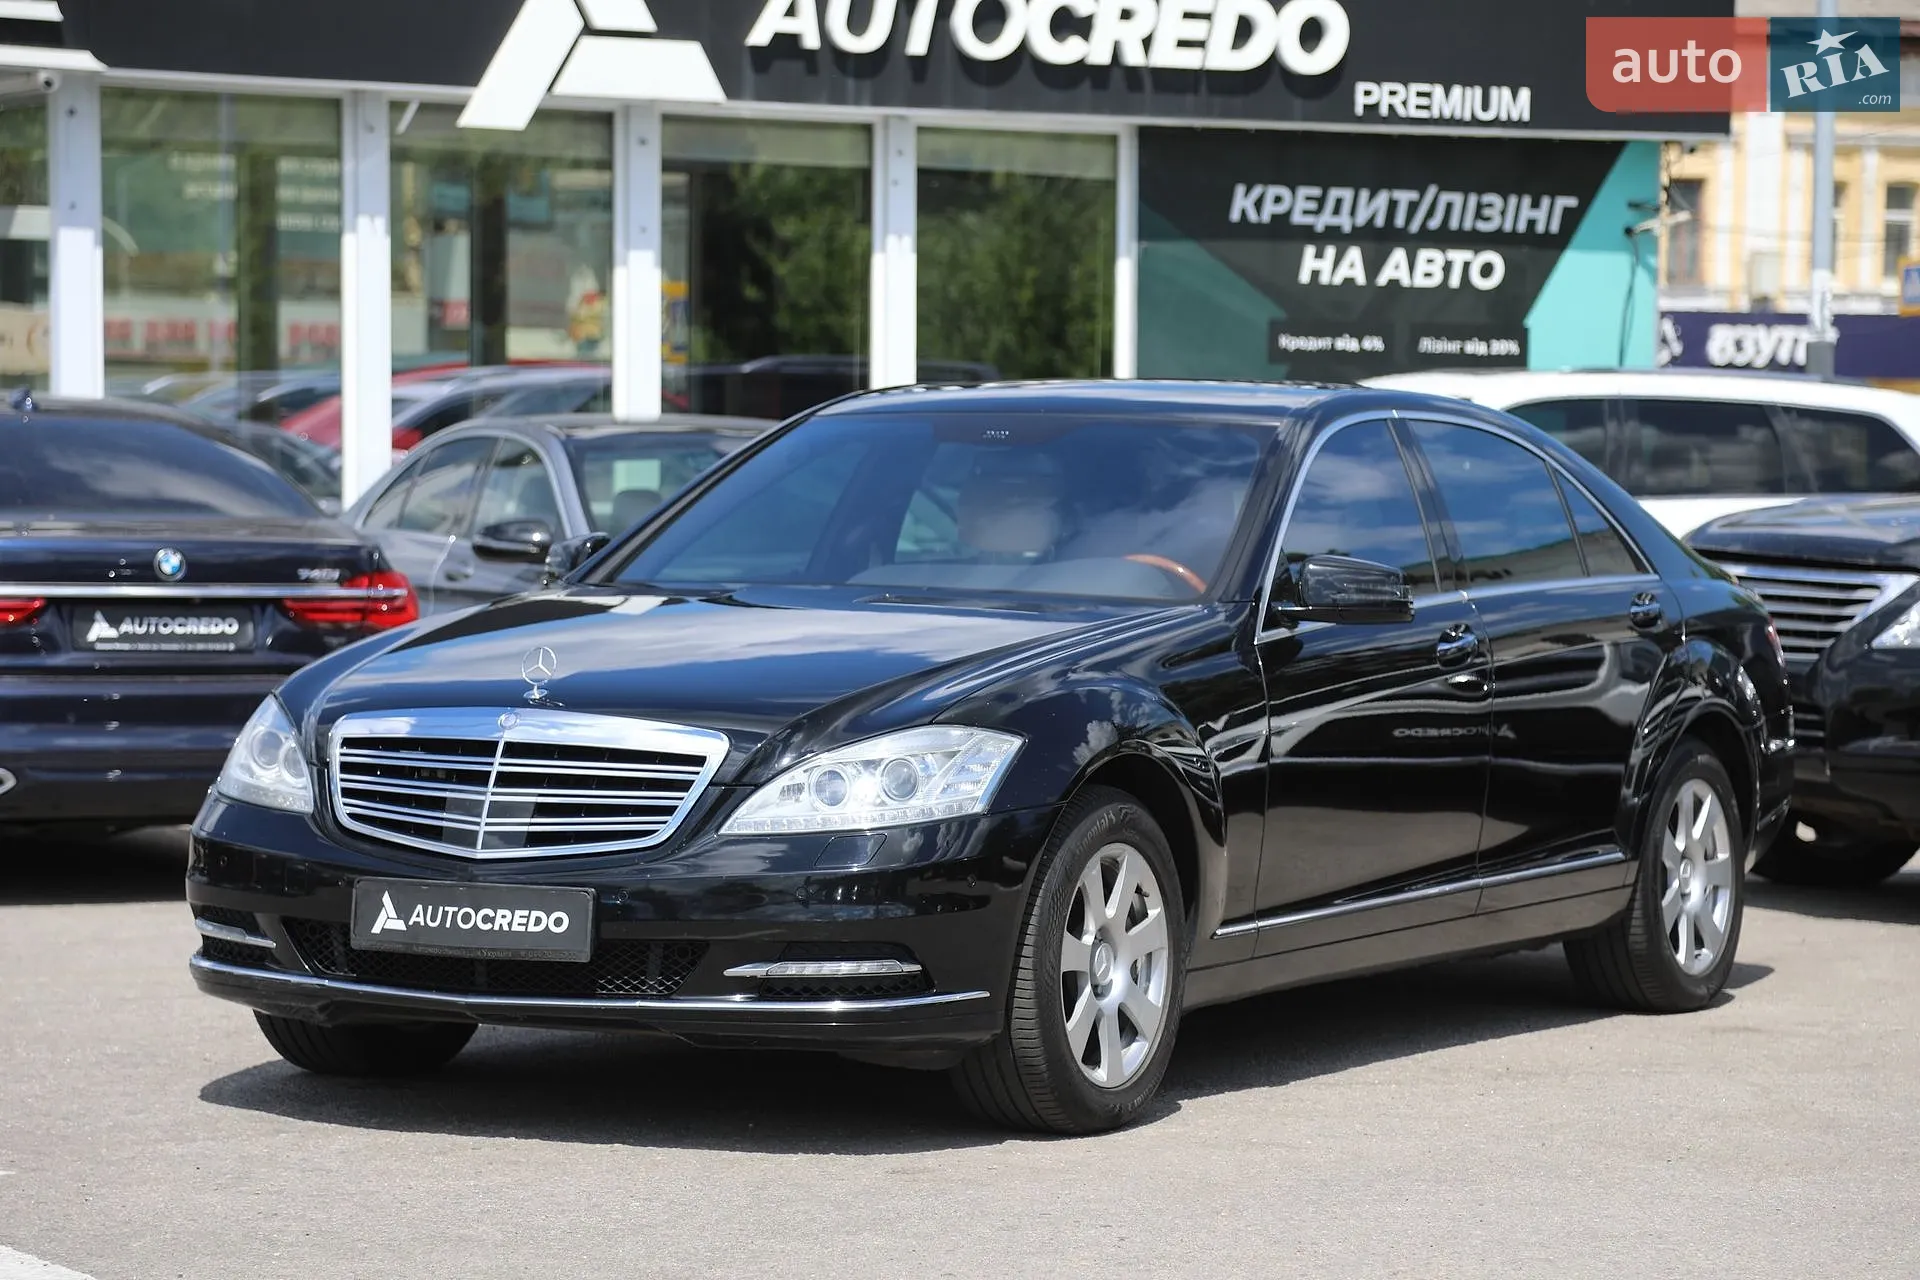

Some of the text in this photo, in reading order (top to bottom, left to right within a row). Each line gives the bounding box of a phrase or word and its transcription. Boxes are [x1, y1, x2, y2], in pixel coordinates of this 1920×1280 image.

[744, 0, 1350, 76] AUTOCREDO
[1354, 81, 1532, 122] PREMIUM
[1228, 183, 1579, 234] КРЕДИТ/ЛІЗІНГ
[1298, 245, 1506, 290] НА АВТО
[118, 616, 239, 635] AUTOCREDO
[408, 904, 569, 933] AUTOCREDO
